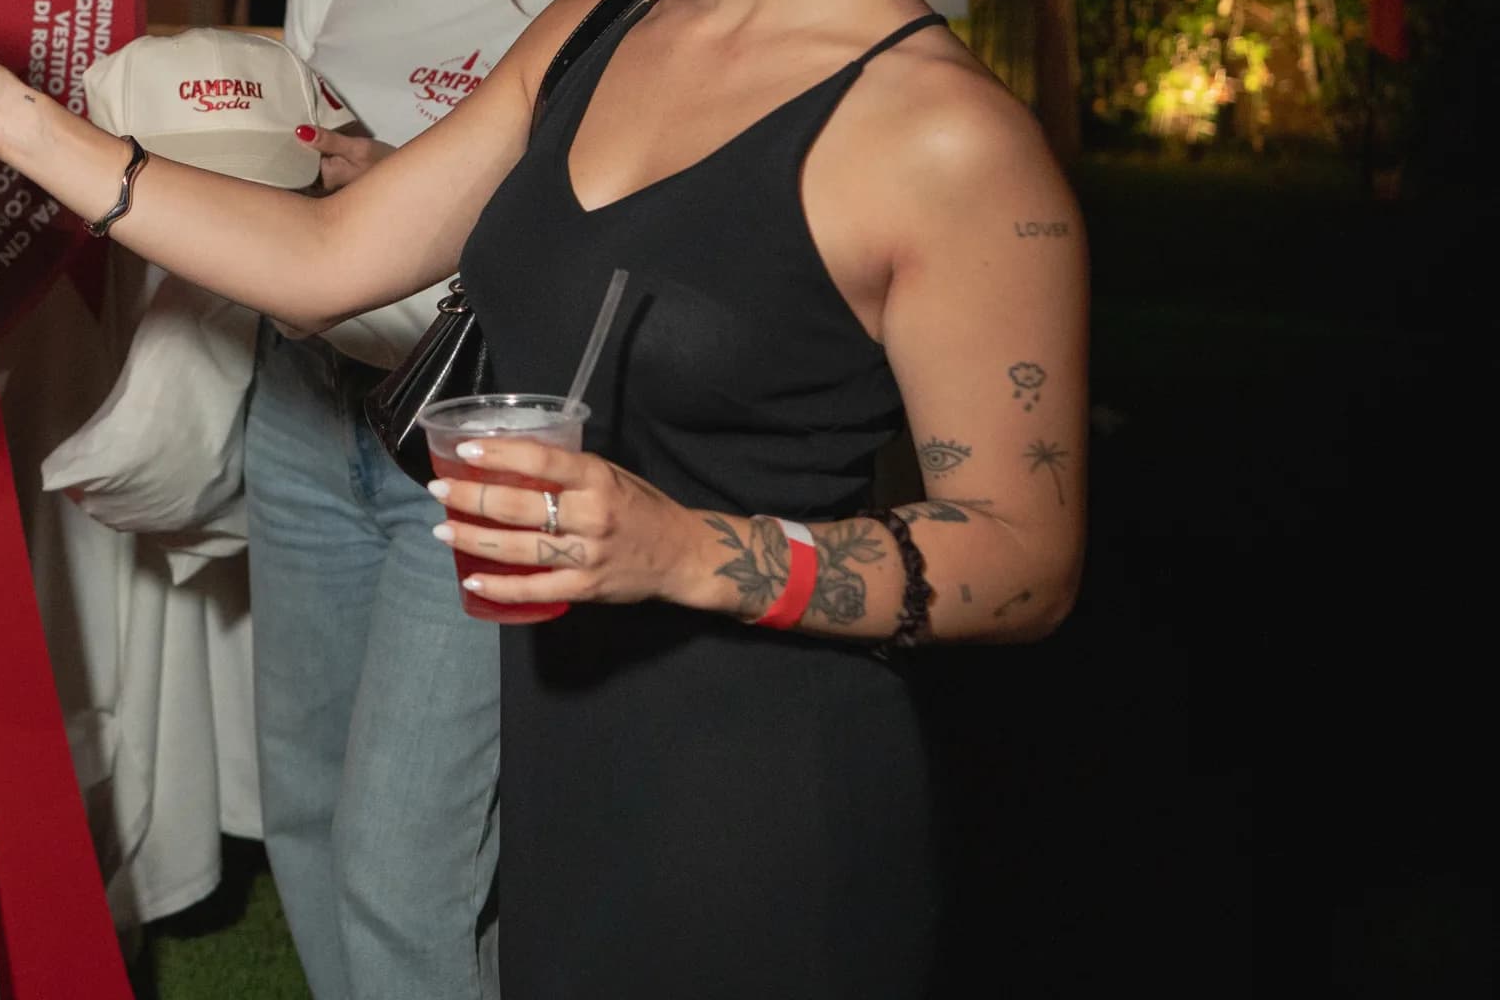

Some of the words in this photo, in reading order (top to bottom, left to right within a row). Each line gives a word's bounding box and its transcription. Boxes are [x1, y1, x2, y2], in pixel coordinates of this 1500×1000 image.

[33, 0, 51, 22] DI
[29, 28, 48, 90] ROSS
[48, 10, 71, 95] VESTITO
[179, 79, 264, 100] CAMPARI
[409, 67, 483, 93] CAMPA
[193, 95, 251, 112] Soda
